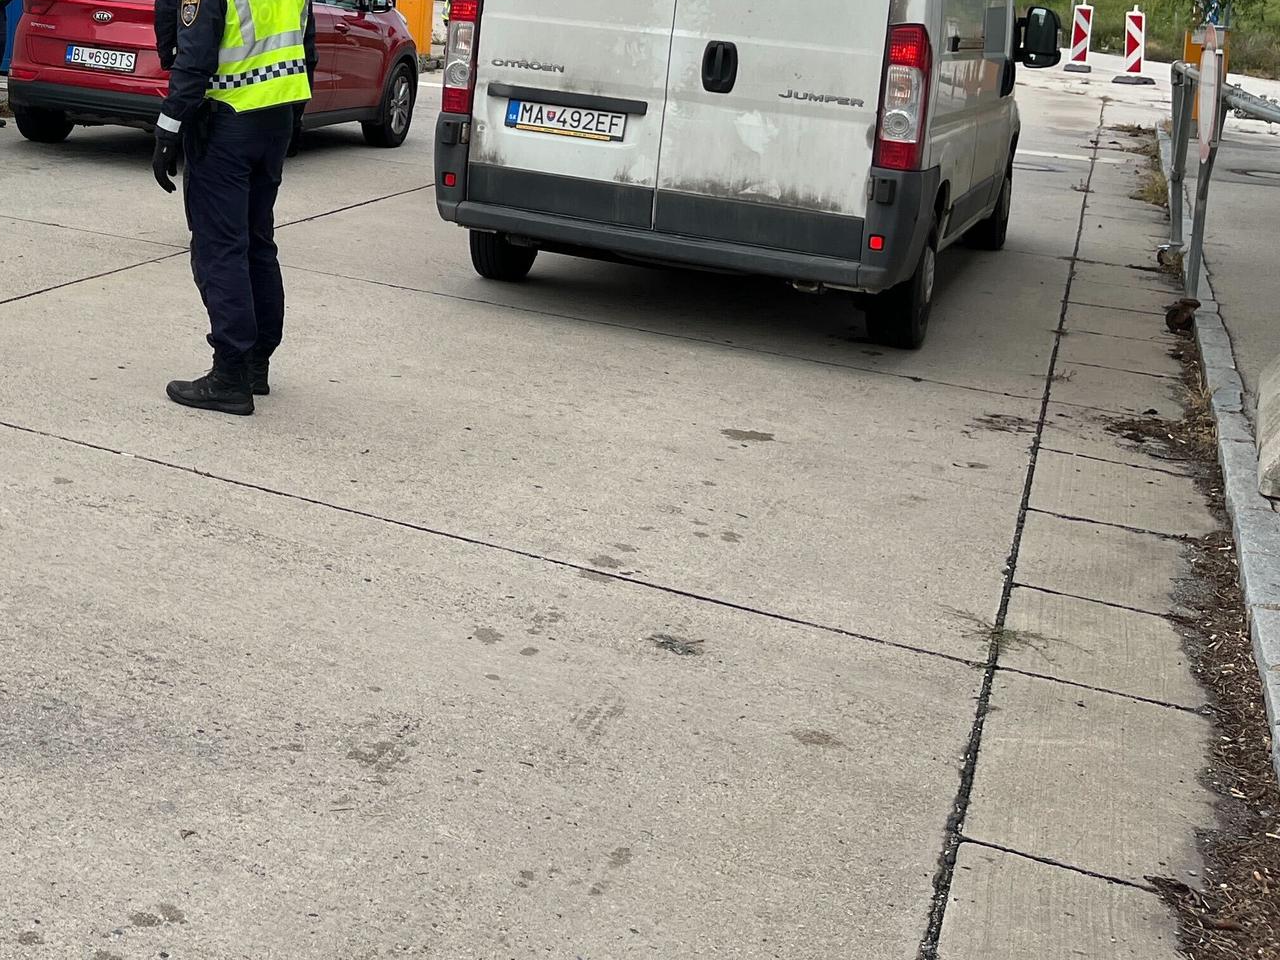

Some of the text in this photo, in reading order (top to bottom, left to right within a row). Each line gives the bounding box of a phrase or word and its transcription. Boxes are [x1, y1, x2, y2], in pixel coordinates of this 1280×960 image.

[73, 47, 87, 62] BL
[94, 50, 134, 68] 699TS
[778, 89, 865, 108] JUMPER
[520, 103, 544, 125] MA
[556, 108, 623, 134] 492EF
